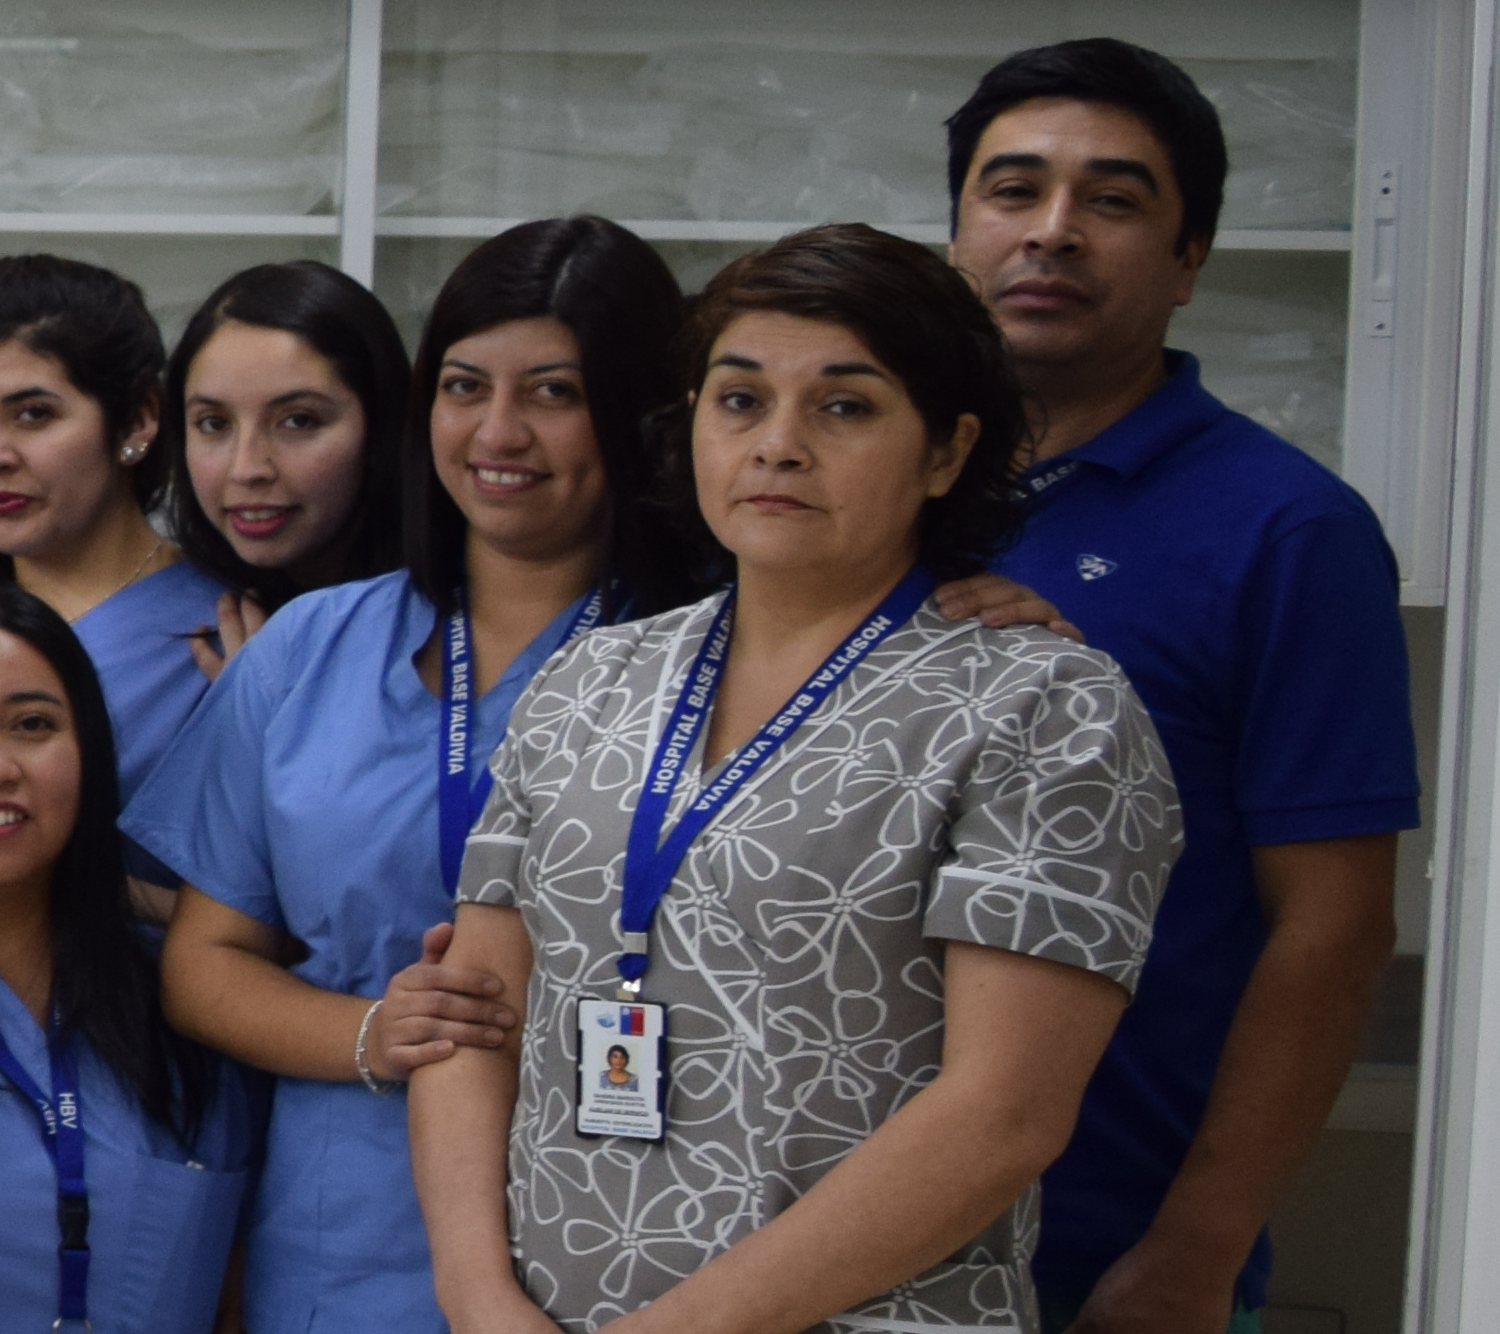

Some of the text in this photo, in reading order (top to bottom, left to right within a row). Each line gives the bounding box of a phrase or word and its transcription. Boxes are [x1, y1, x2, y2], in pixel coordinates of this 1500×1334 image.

[447, 608, 469, 776] PITAL BASE VALDIVIA
[650, 711, 700, 795] HOSPITAL
[686, 662, 718, 709] BASE
[693, 614, 893, 812] HOSPITAL BASE VALDIVIA
[58, 1091, 79, 1130] HBV
